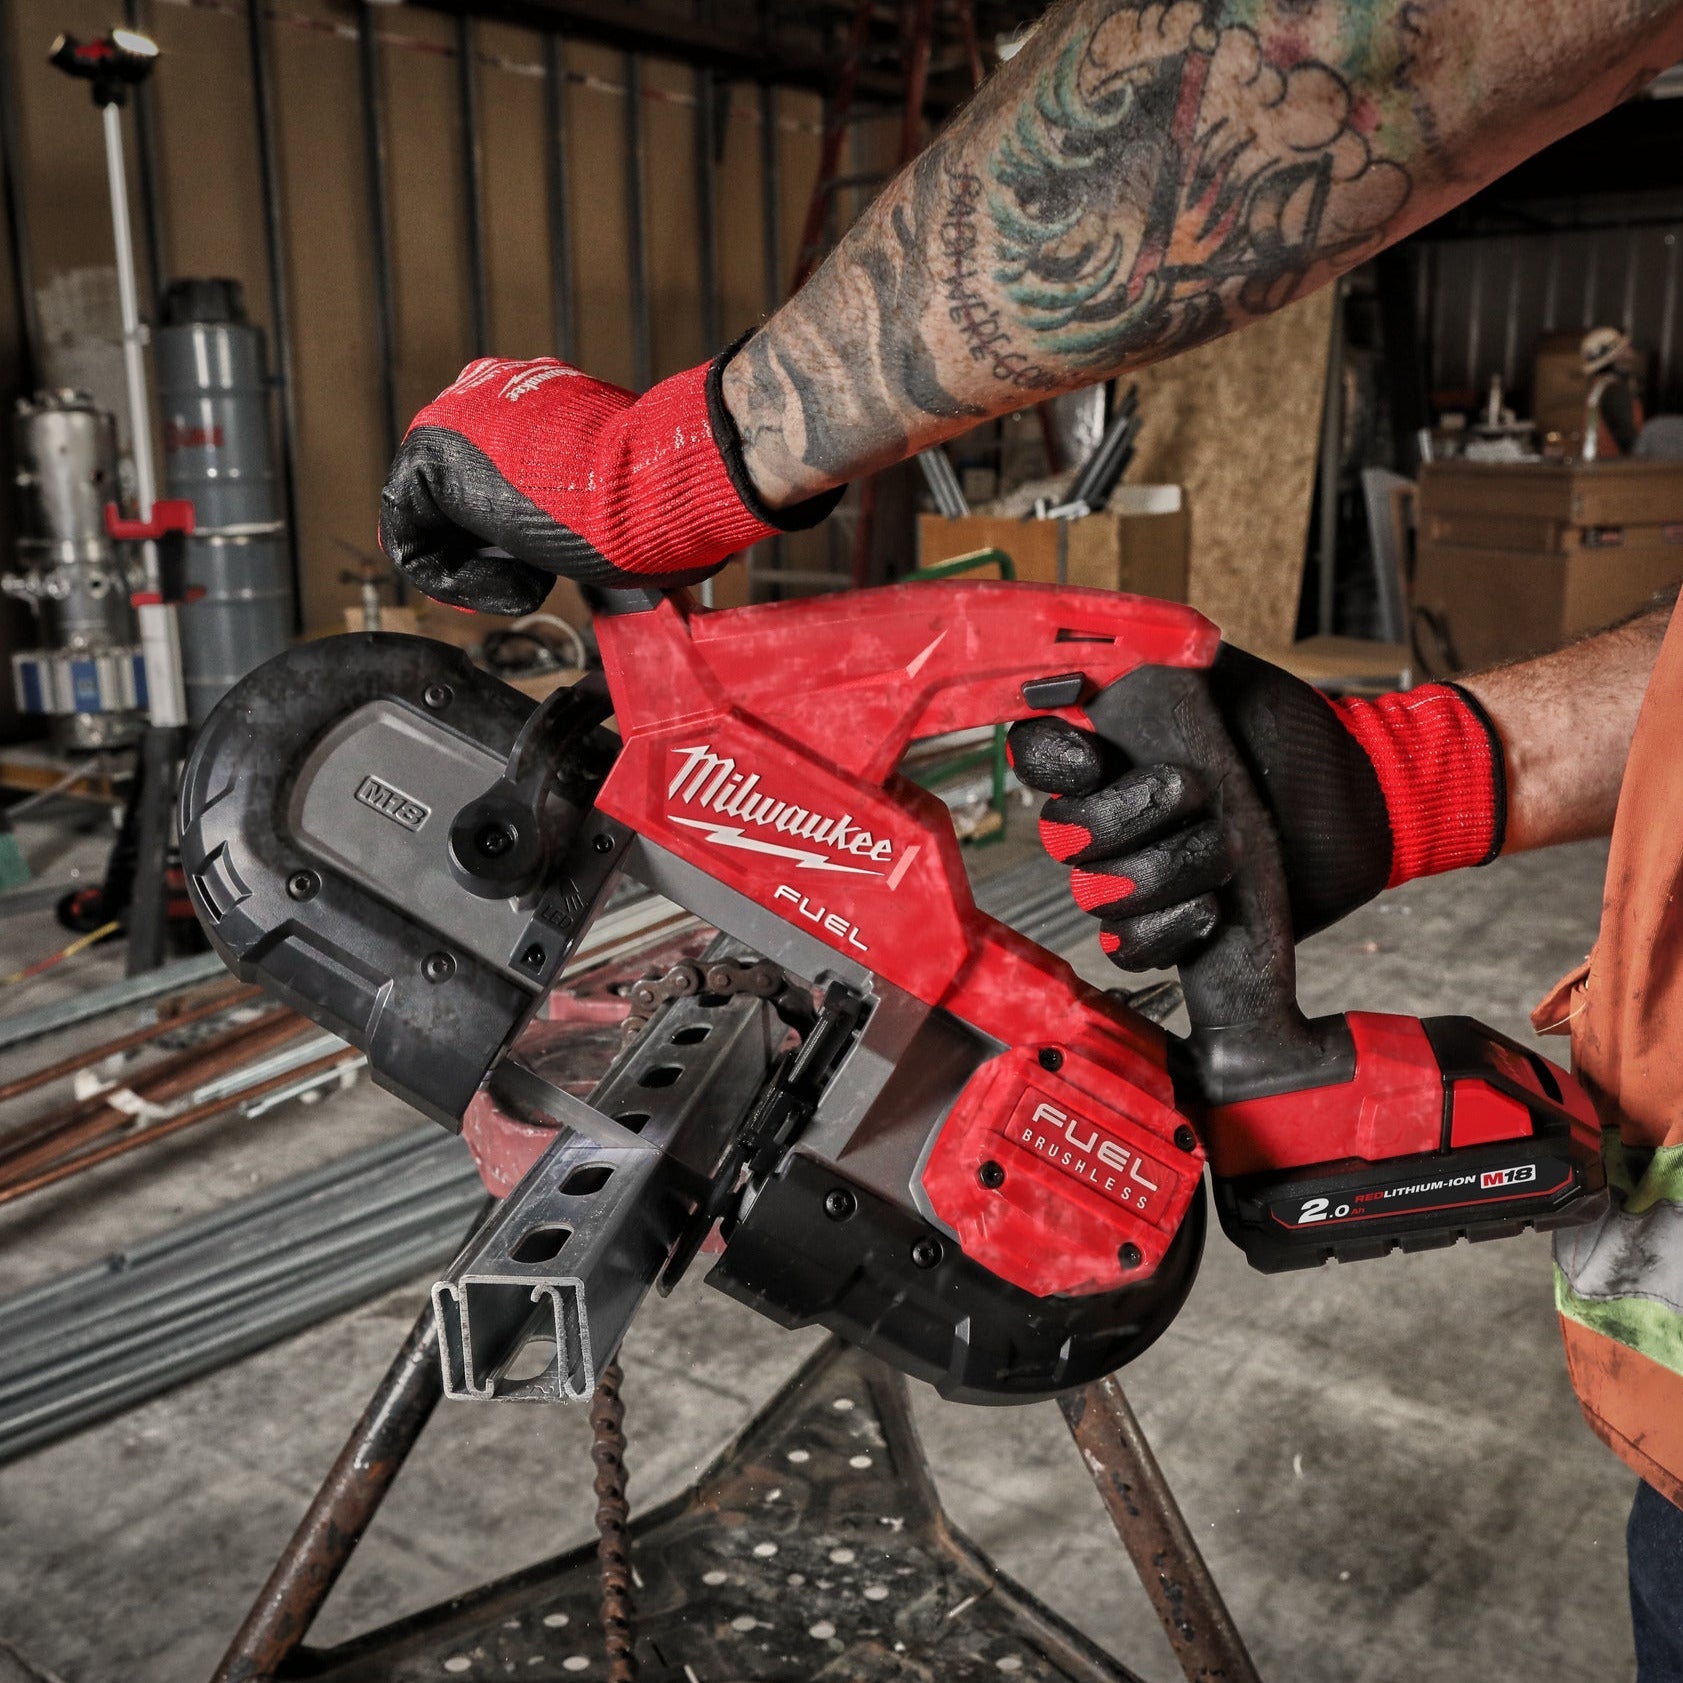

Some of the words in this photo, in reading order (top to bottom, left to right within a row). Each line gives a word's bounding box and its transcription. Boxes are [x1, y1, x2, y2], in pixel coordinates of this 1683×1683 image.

[359, 780, 427, 825] M18
[667, 744, 893, 862] Milwaukee
[541, 904, 573, 929] LED
[773, 884, 869, 952] FUEL
[1022, 1128, 1148, 1209] BRUSHLESS
[1032, 1103, 1158, 1192] FUEL
[1483, 1166, 1534, 1187] M18
